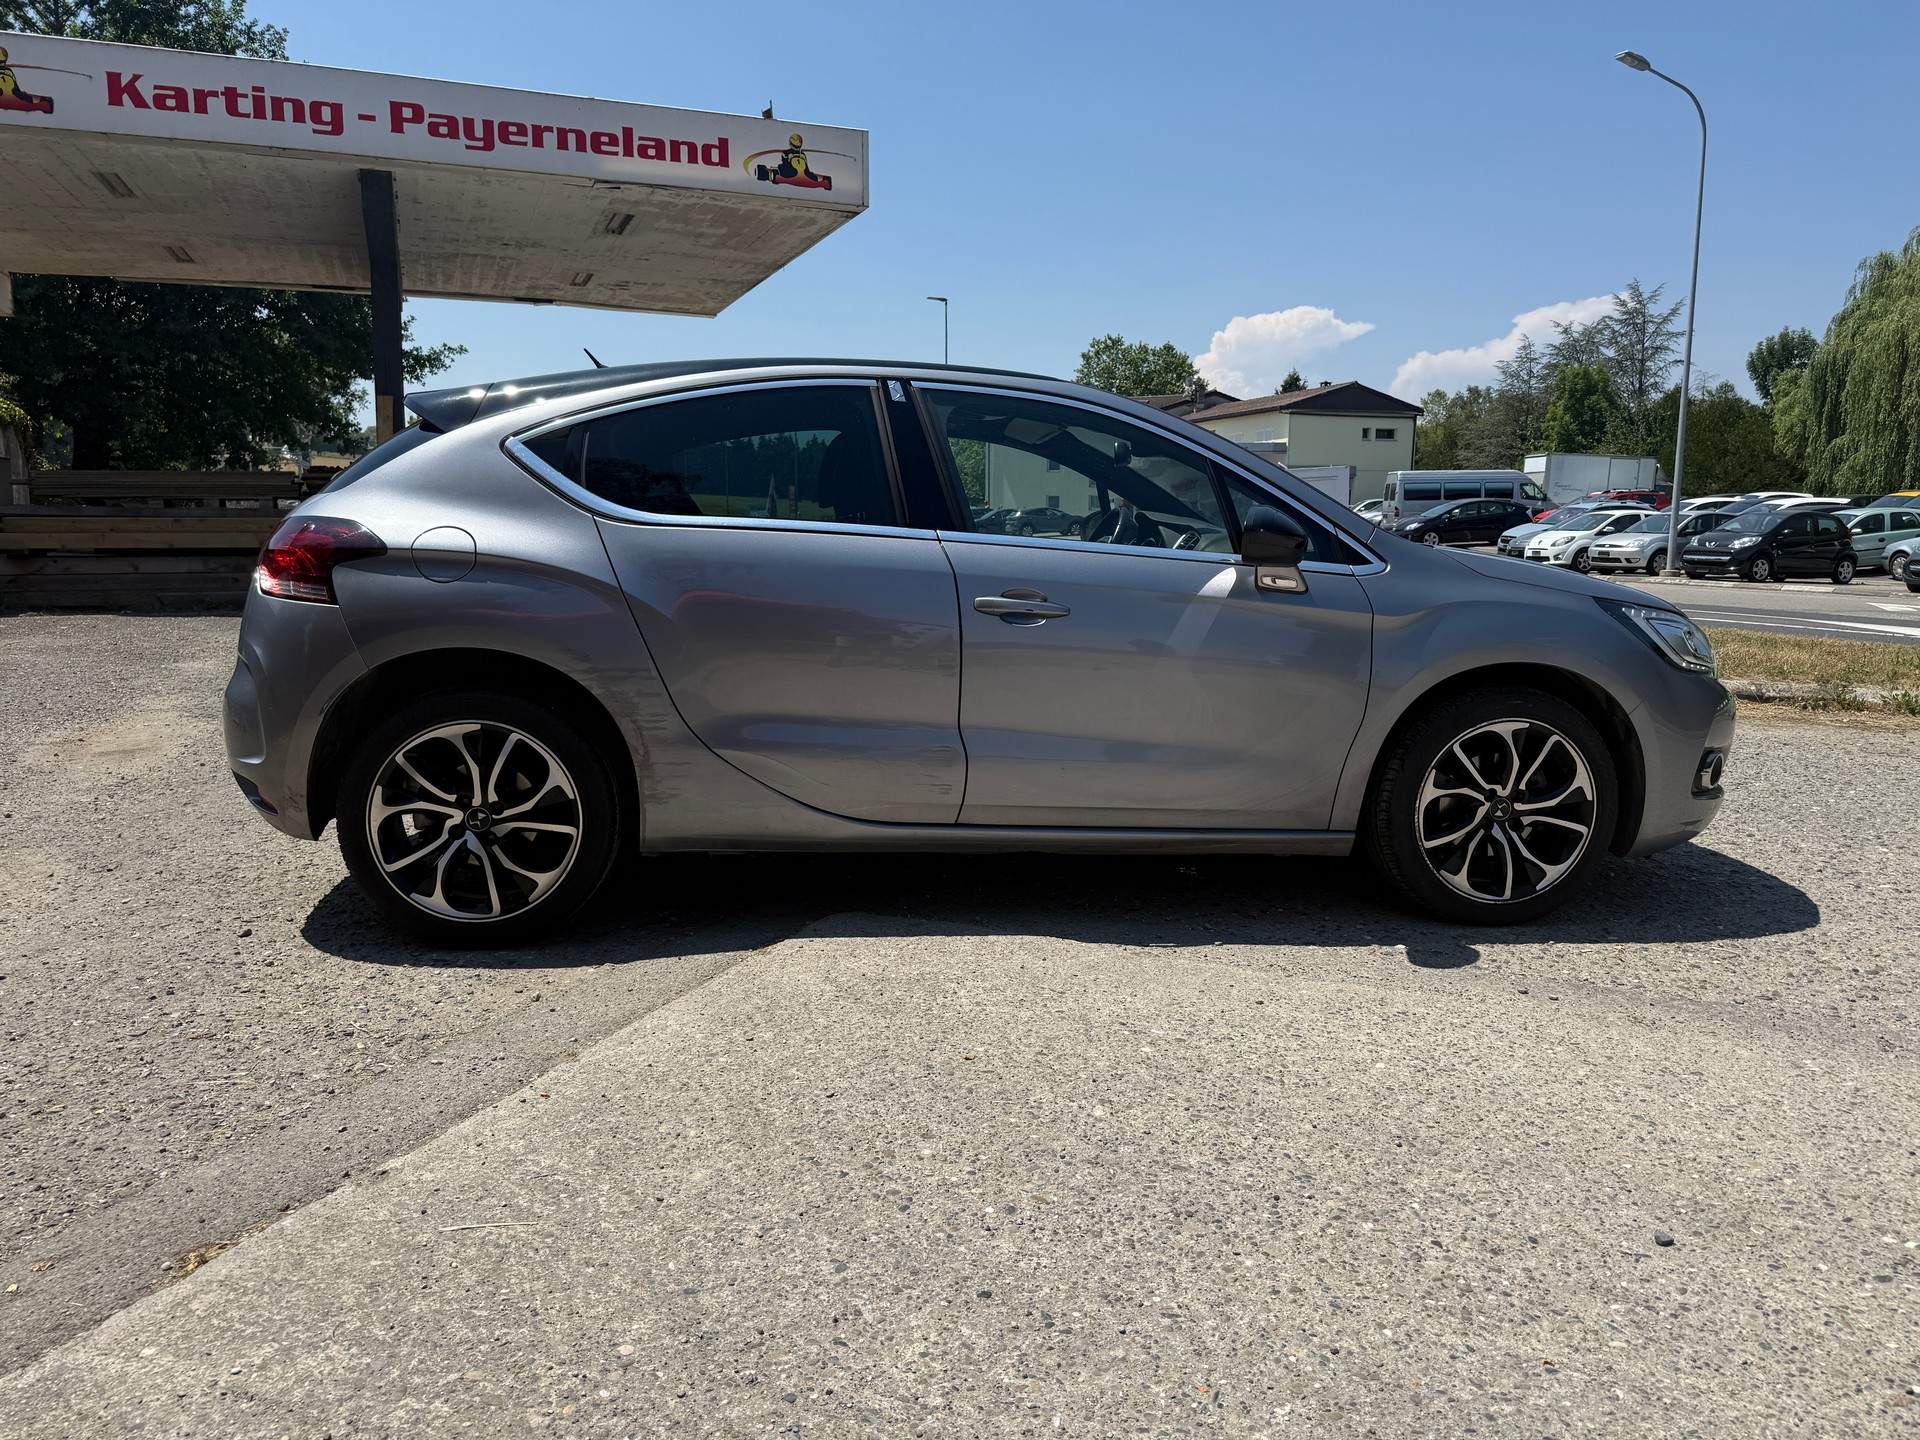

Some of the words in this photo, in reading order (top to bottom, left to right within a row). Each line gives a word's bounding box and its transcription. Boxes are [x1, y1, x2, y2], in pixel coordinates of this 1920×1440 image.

[105, 71, 344, 136] Karting
[358, 114, 375, 122] -
[390, 102, 730, 168] Payerneland
